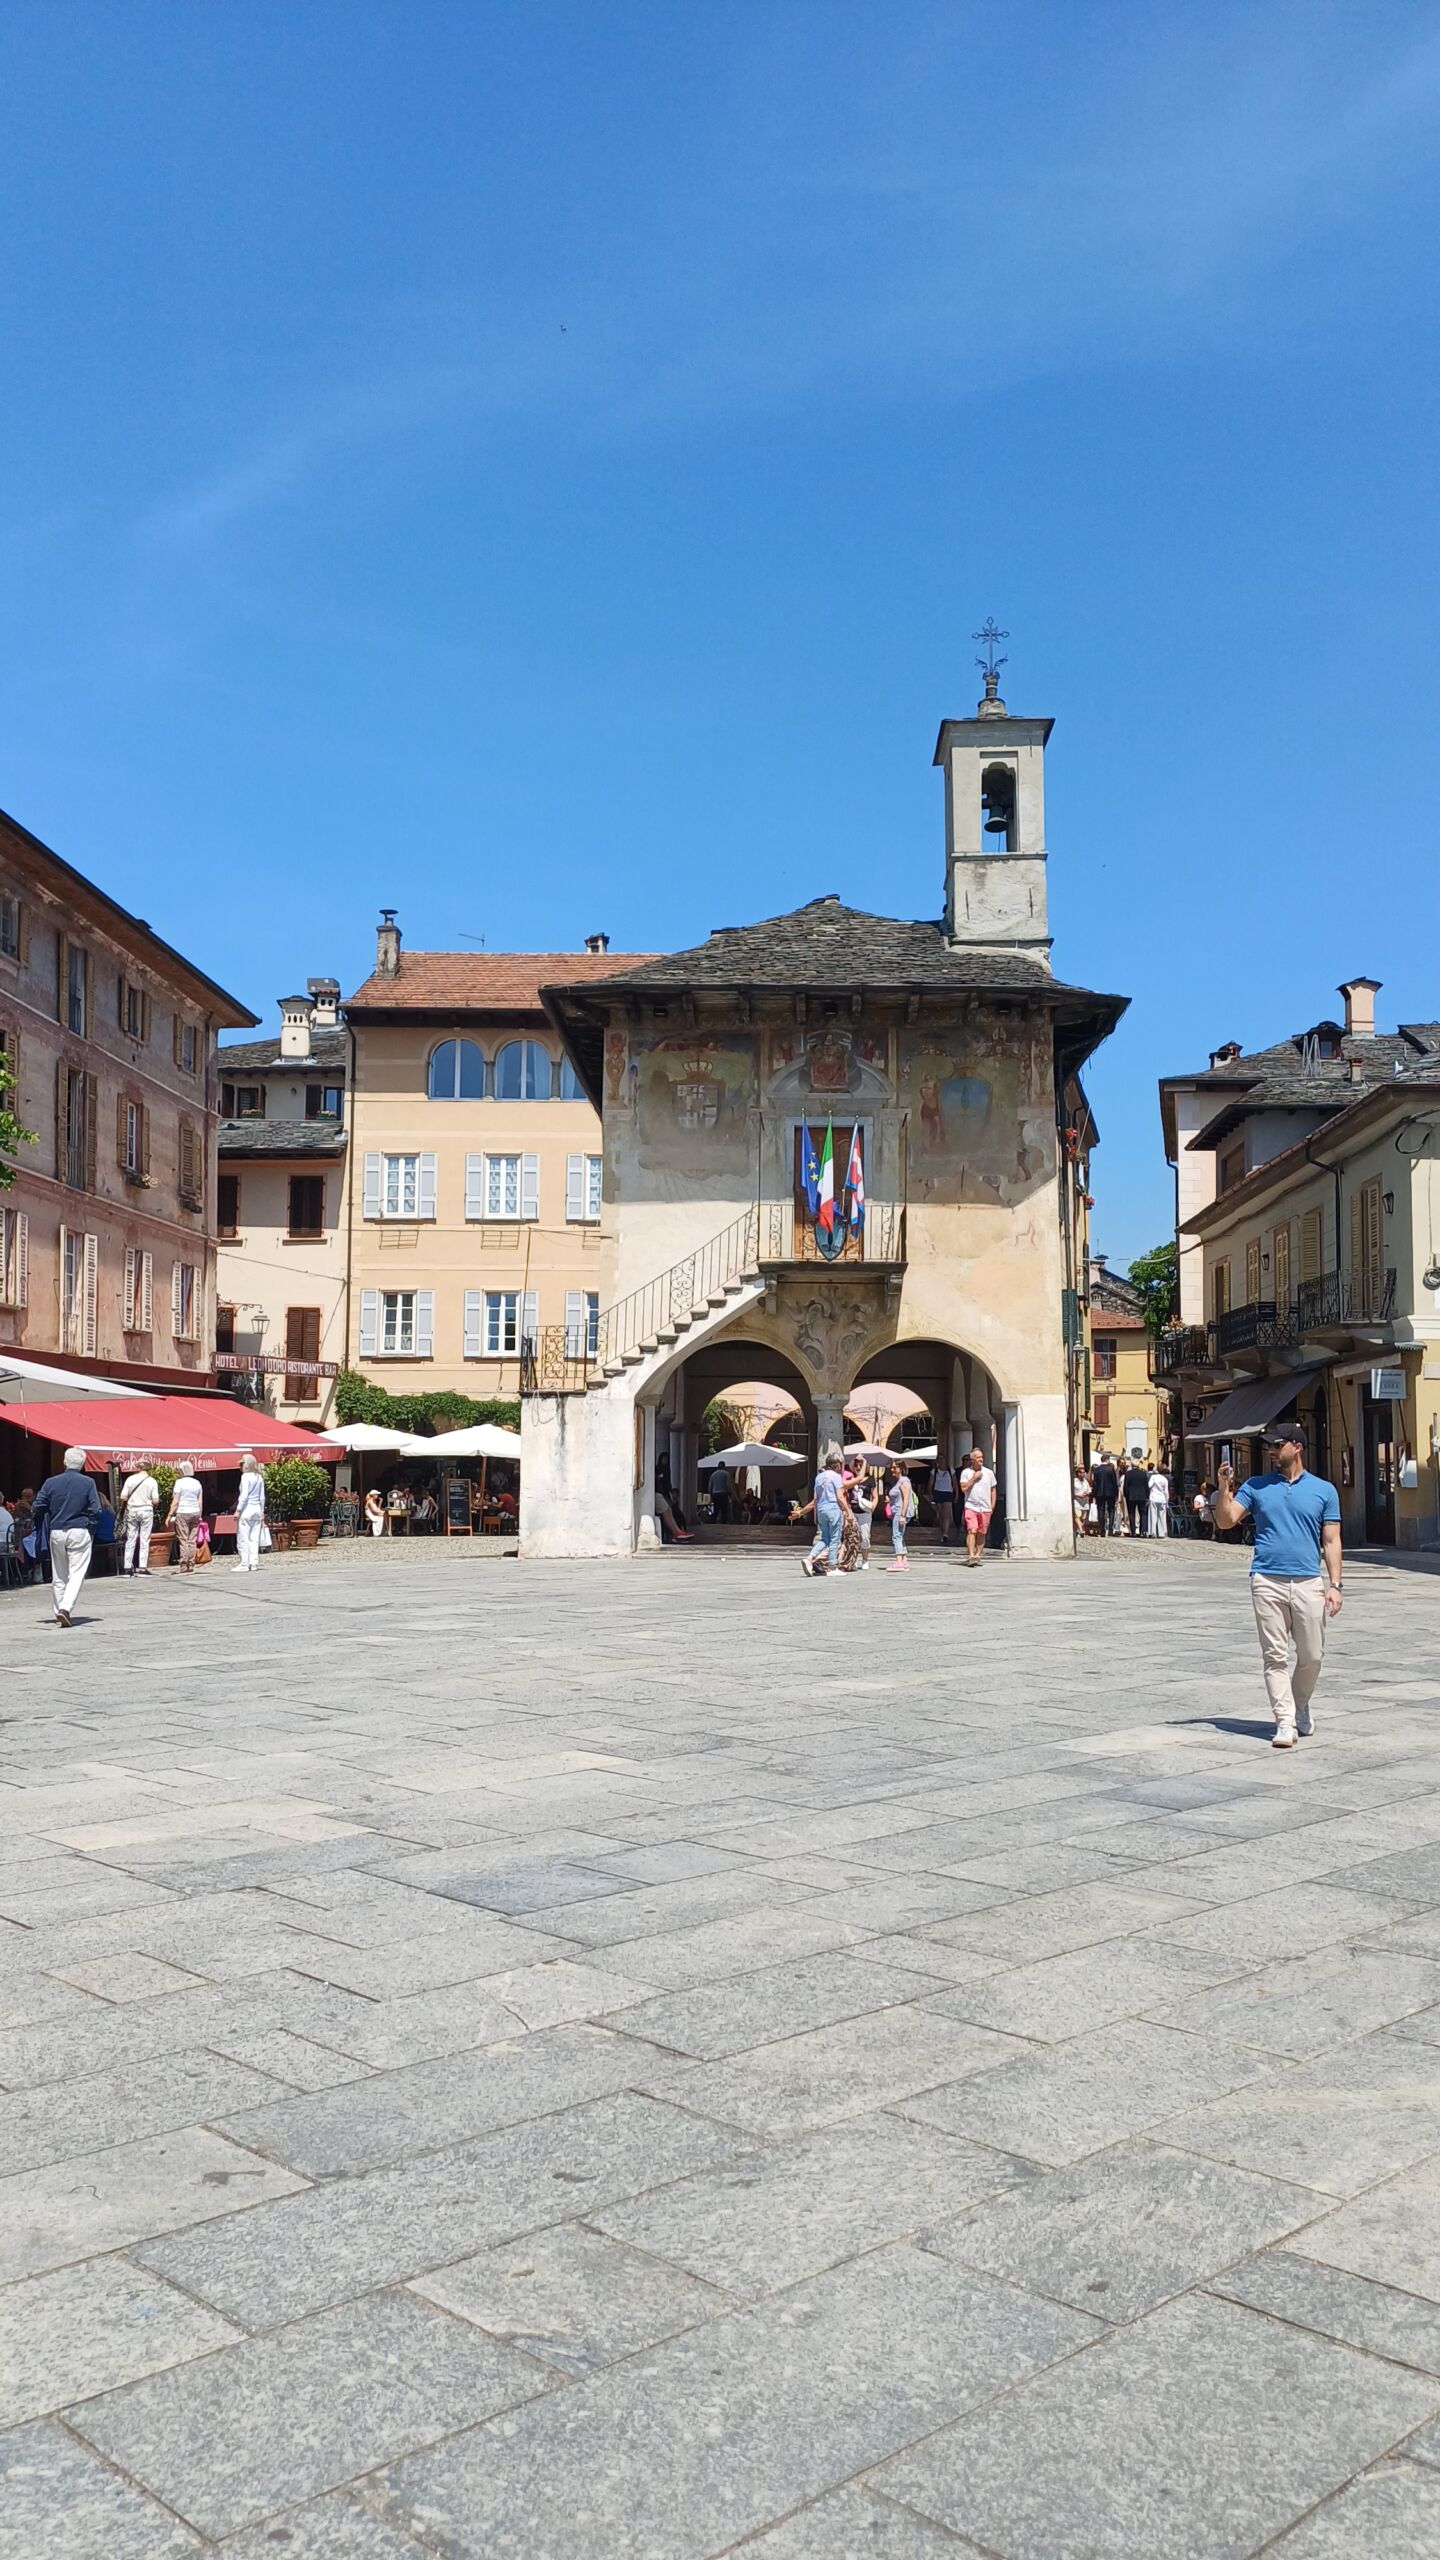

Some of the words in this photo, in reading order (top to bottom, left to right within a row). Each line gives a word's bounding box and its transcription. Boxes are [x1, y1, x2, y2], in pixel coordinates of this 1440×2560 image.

[214, 1354, 239, 1369] HOTEL
[287, 1360, 324, 1376] RISTORANTE
[324, 1363, 337, 1377] BAR
